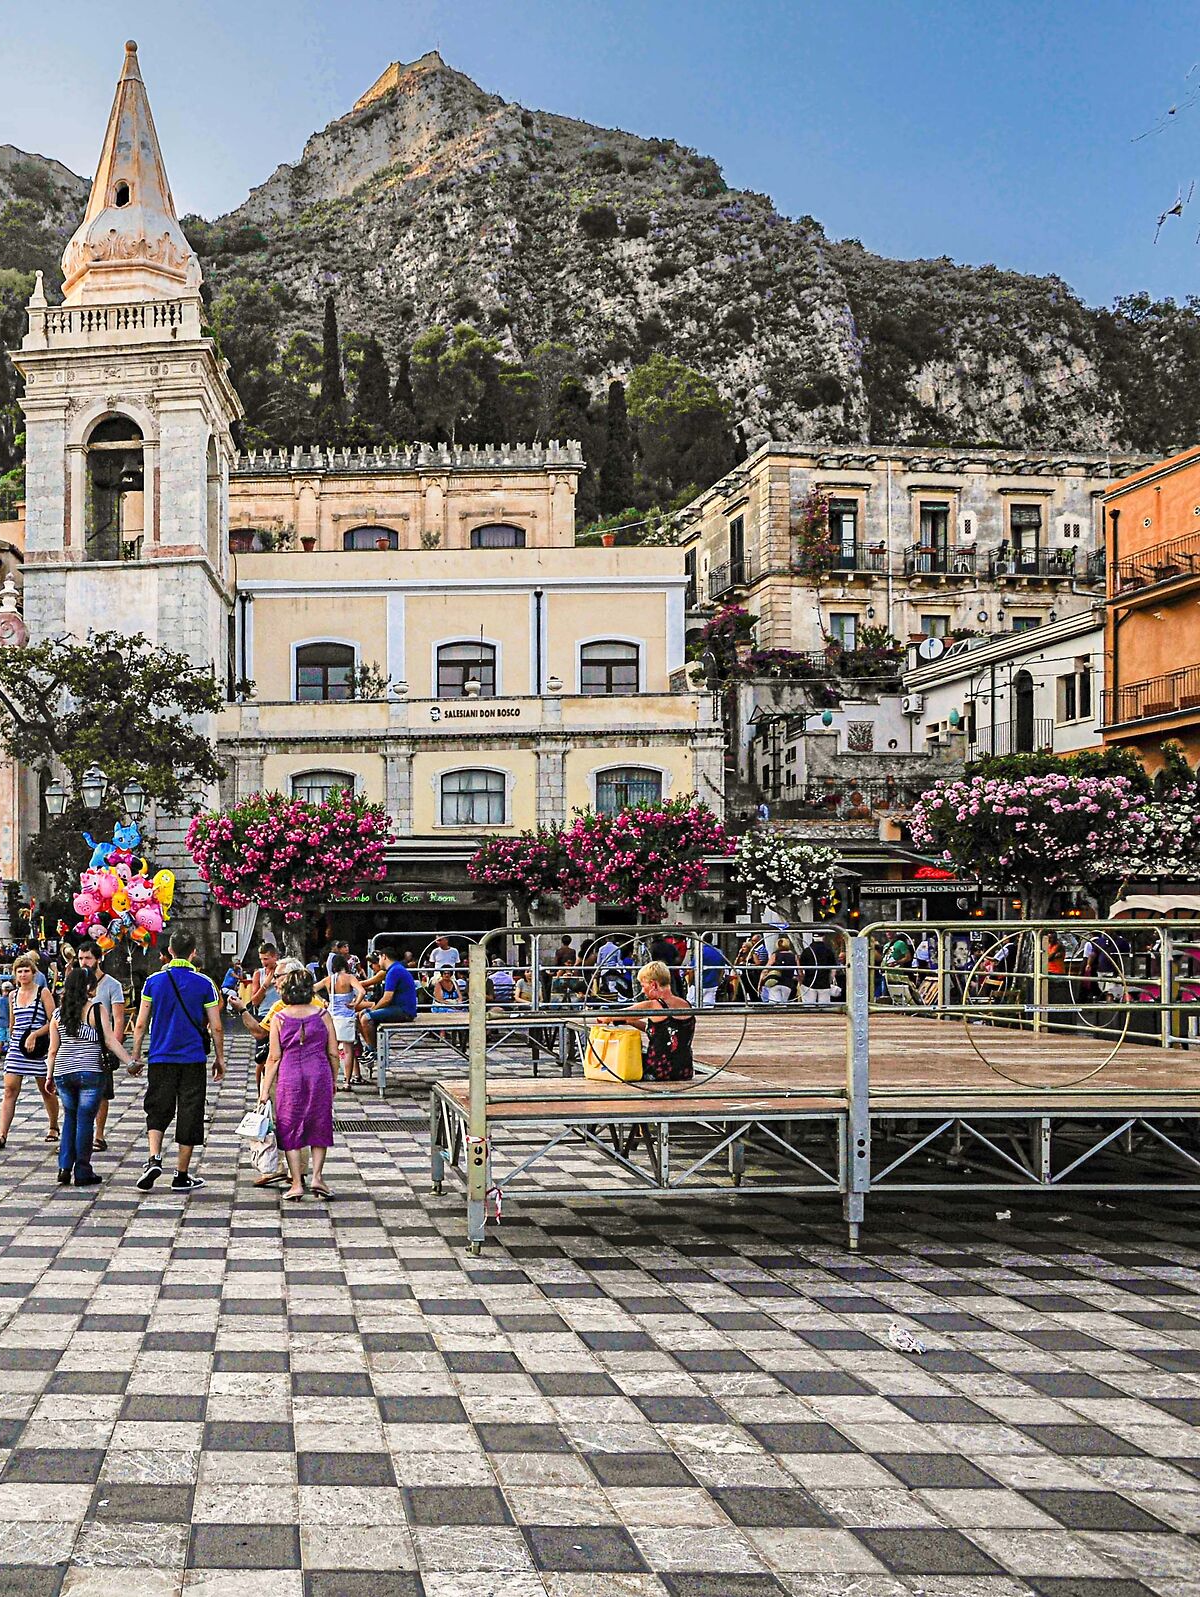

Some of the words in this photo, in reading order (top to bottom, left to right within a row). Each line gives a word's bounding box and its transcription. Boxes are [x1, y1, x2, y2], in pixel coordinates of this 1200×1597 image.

[444, 709, 478, 719] SALESIANI
[480, 709, 495, 718] DON
[497, 708, 521, 717] BOSCO
[427, 891, 457, 902] Room
